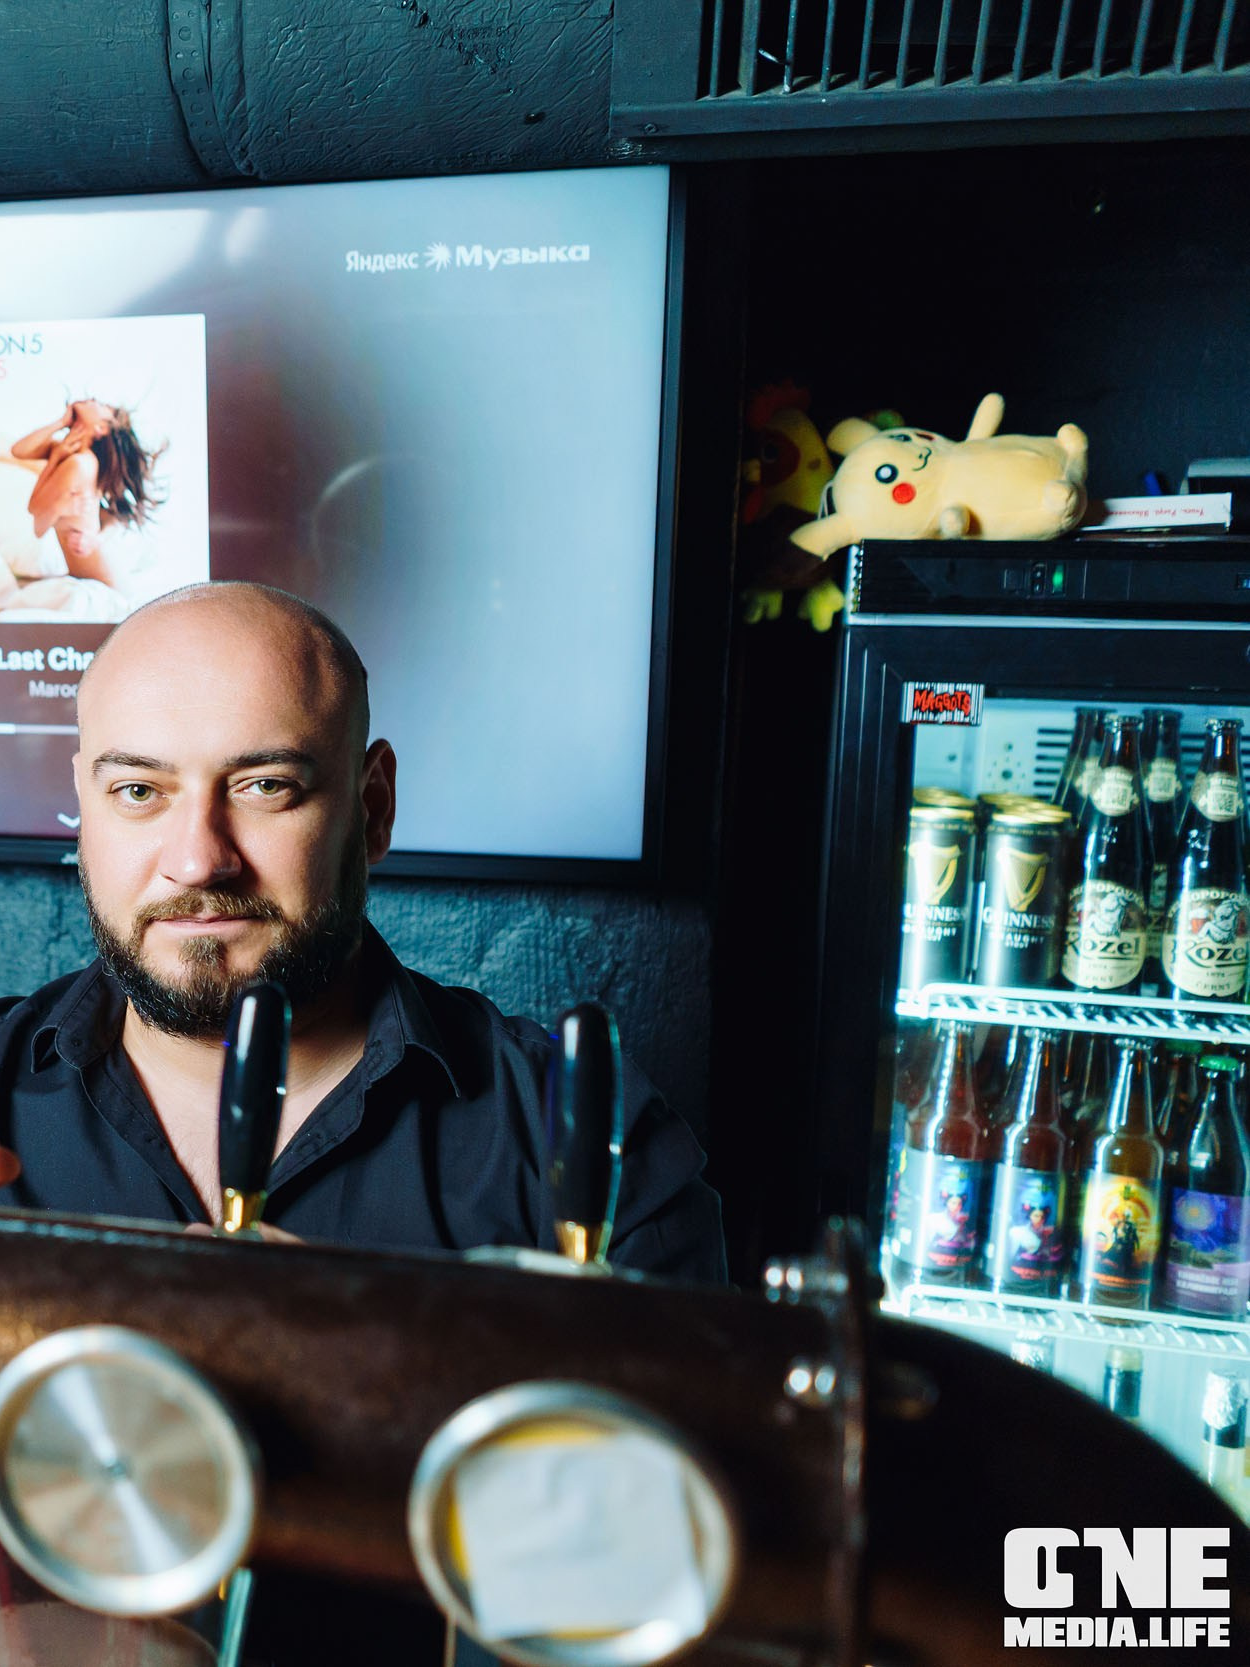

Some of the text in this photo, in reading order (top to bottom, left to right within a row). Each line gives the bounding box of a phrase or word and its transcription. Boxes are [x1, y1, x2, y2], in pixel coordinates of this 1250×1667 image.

[345, 244, 590, 274] Яндекс Музыка
[30, 332, 43, 355] 5
[904, 902, 967, 922] UNNES
[982, 906, 1055, 929] GINNESS
